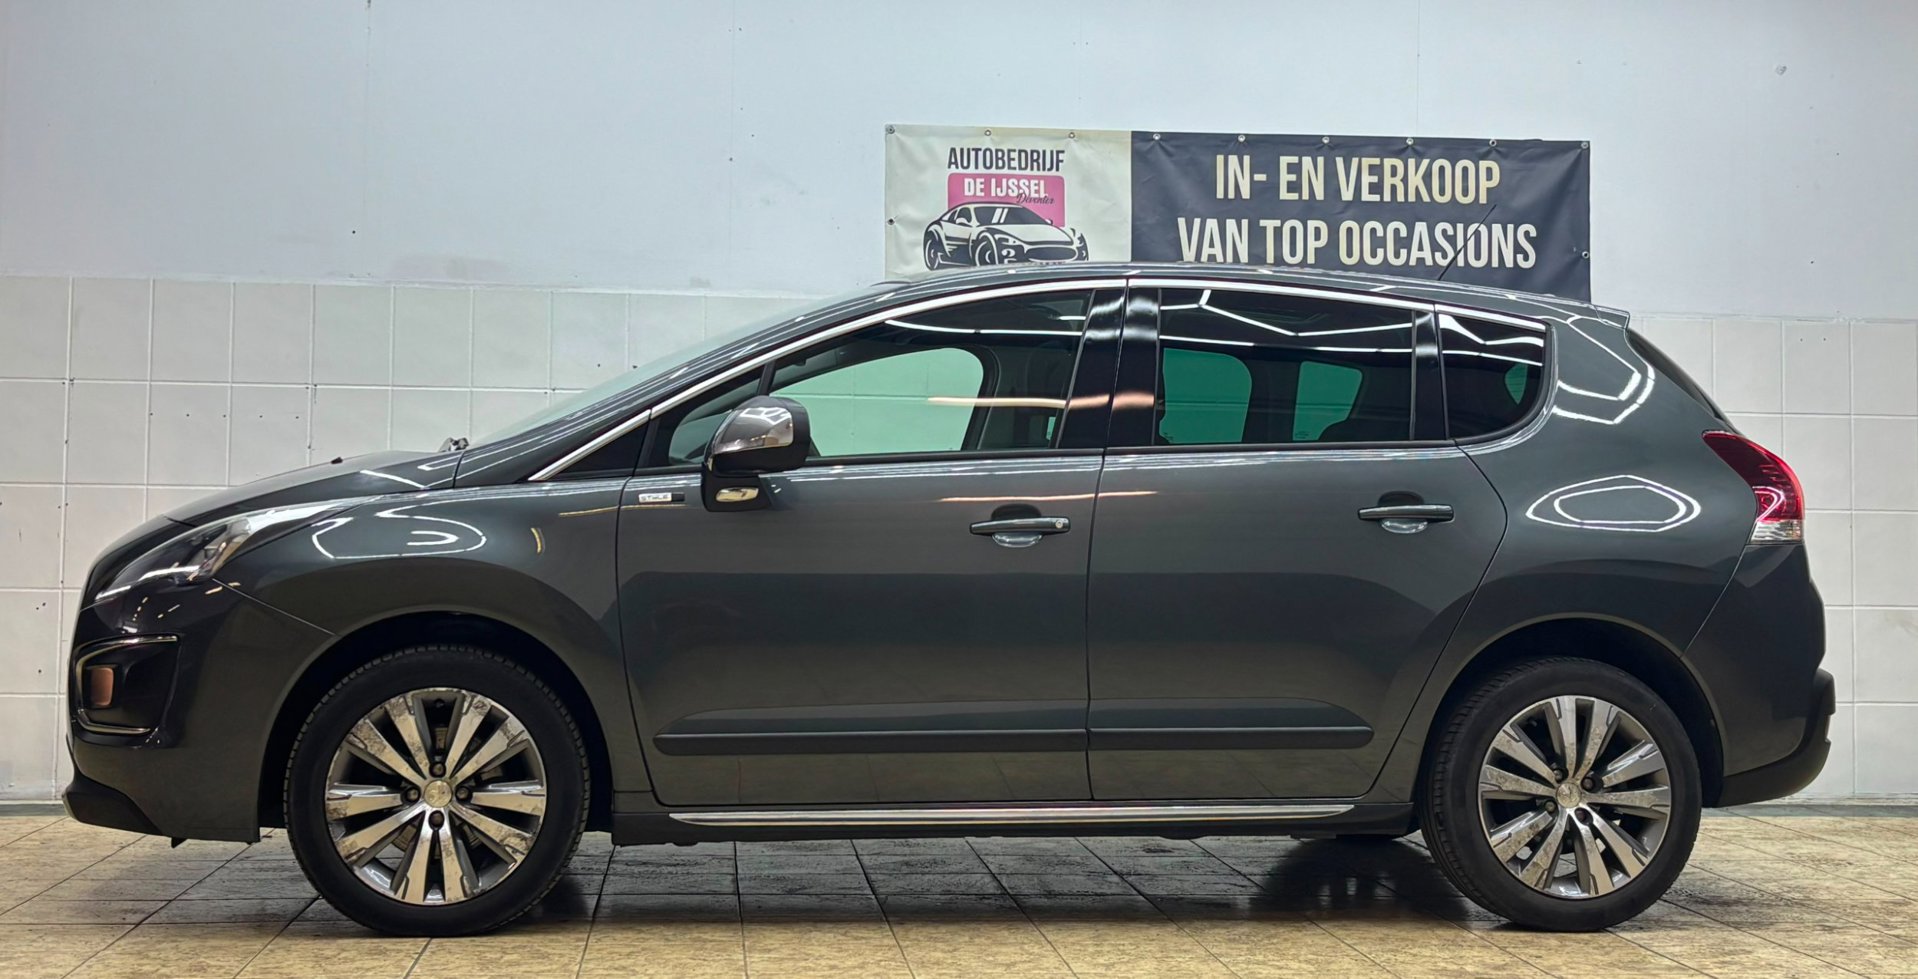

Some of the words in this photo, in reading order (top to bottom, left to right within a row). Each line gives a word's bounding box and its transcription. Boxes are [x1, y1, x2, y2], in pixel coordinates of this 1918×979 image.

[948, 147, 1065, 172] AUTOBEDRIJF
[964, 178, 985, 197] DE
[991, 178, 1048, 198] IJSSEL
[1216, 154, 1267, 199] IN-
[1279, 155, 1325, 200] EN
[1335, 156, 1500, 204] VERKOOP
[1177, 217, 1249, 263] VAN
[1259, 219, 1329, 265] TOP
[1339, 220, 1537, 269] OCCASIONS
